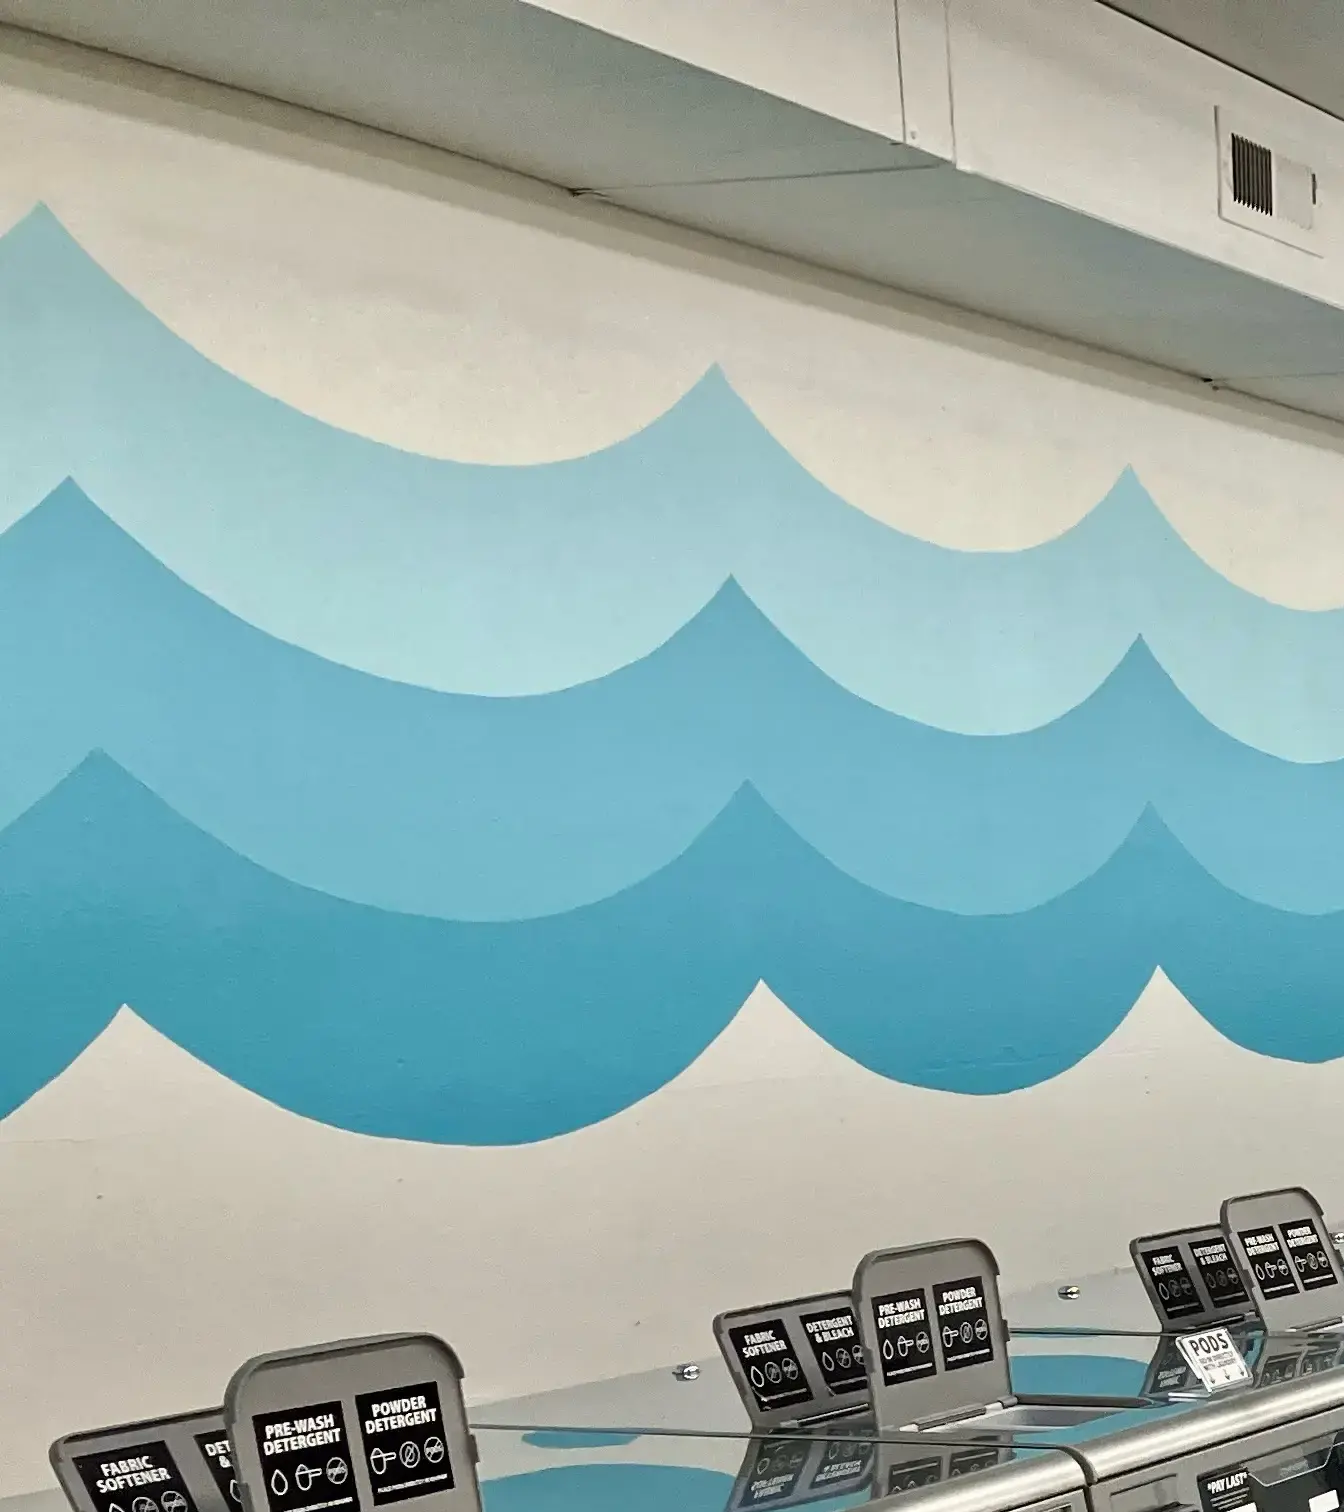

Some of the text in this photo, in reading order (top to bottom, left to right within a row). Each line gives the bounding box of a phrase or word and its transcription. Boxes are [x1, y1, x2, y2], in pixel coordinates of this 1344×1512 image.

[942, 1286, 977, 1303] POWDER
[878, 1298, 922, 1316] PRE-WASH
[938, 1297, 984, 1316] DETERGENT
[805, 1315, 853, 1334] DETERGENT
[877, 1309, 926, 1329] DETERGENT
[743, 1329, 776, 1343] FABRIC
[823, 1327, 855, 1342] BLEACH
[1188, 1332, 1229, 1356] PODS
[742, 1340, 788, 1359] SOFTENER
[371, 1395, 427, 1418] POWDER
[265, 1413, 335, 1440] PRE-WASH
[364, 1408, 437, 1435] DETERGENT
[263, 1427, 342, 1456] DETERGENT
[100, 1455, 154, 1477] FABRIC
[95, 1467, 172, 1494] SOFTENER
